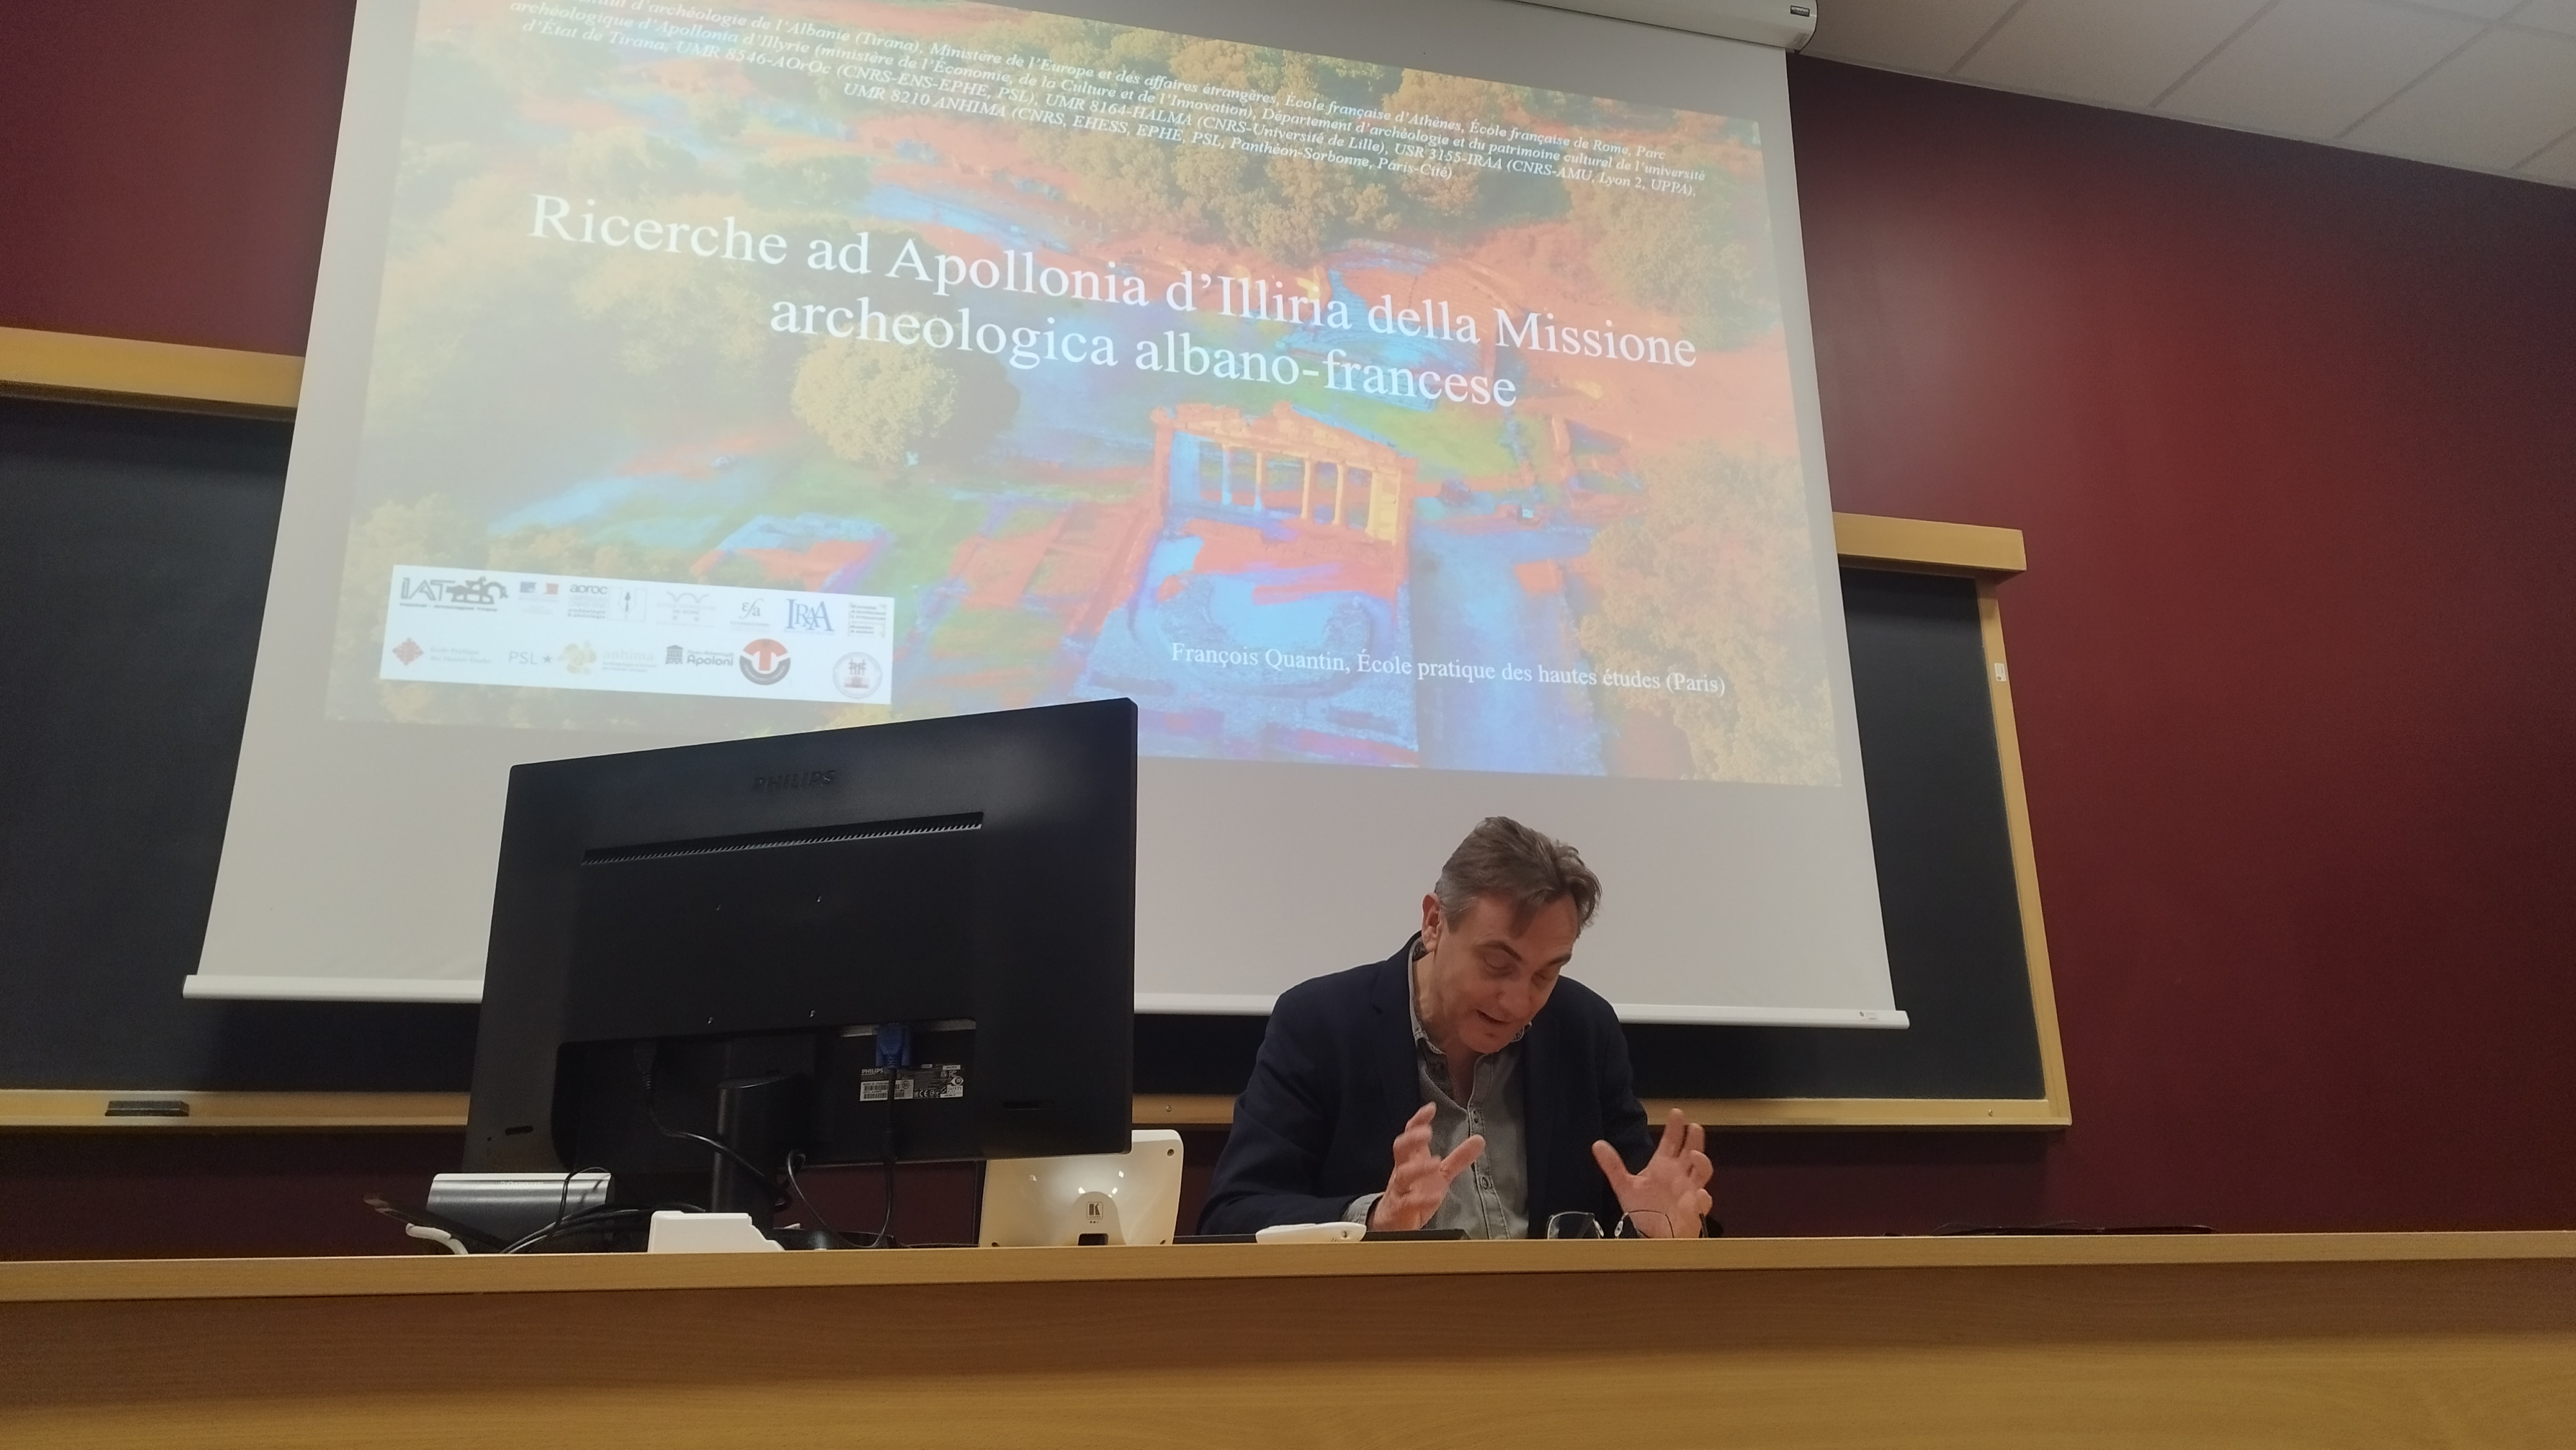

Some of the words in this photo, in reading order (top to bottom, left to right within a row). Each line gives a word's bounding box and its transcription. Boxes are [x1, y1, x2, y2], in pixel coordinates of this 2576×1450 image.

[583, 26, 602, 41] de
[676, 40, 720, 57] UMR
[837, 62, 991, 100] (CNRS-ENS-EPHE,
[1045, 92, 1085, 109] UMR
[1090, 99, 1191, 125] 8164-HALMA
[1197, 113, 1323, 144] (CNRS-Université
[1328, 132, 1345, 146] de
[1348, 135, 1388, 156] Lille),
[1395, 141, 1424, 158] USR
[1600, 170, 1631, 189] Lyon
[1635, 175, 1646, 193] 2,
[1651, 177, 1696, 199] UPPA),
[638, 15, 739, 42] d'Apollonia
[743, 31, 810, 54] d'Illyrie
[815, 41, 894, 65] (ministère
[898, 53, 916, 68] de
[1018, 70, 1036, 85] de
[1041, 73, 1056, 88] la
[1061, 77, 1116, 97] Culture
[1121, 86, 1134, 99] et
[1138, 88, 1156, 102] de
[1262, 105, 1352, 130] Département
[1454, 133, 1465, 146] et
[1468, 135, 1486, 149] du
[1488, 140, 1560, 160] patrimoine
[1564, 149, 1613, 167] culturel
[1616, 155, 1631, 169] de
[1636, 158, 1705, 180] l'université
[752, 14, 772, 29] de
[777, 18, 850, 41] l'Albanie
[929, 41, 1002, 63] Ministère
[1005, 52, 1025, 66] de
[1029, 55, 1095, 80] l'Europe
[1098, 66, 1112, 79] et
[1117, 68, 1140, 84] des
[1144, 73, 1198, 92] affaires
[1285, 89, 1324, 110] École
[1327, 98, 1392, 120] française
[1469, 115, 1507, 136] École
[1508, 124, 1571, 145] française
[1574, 133, 1589, 147] de
[1637, 142, 1666, 158] Parc
[844, 81, 885, 99] UMR
[890, 88, 930, 105] 8210
[933, 93, 1005, 115] ANHIMA
[1011, 104, 1067, 128] (CNRS,
[1073, 113, 1131, 137] EHESS,
[1136, 122, 1185, 144] EPHE,
[1191, 129, 1224, 150] PSL,
[1378, 155, 1452, 182] Paris-Cité)
[529, 195, 788, 265] Ricerche
[807, 232, 870, 276] ad
[885, 238, 1150, 307] Apollonia
[1166, 272, 1352, 330] d'Illiria
[1368, 294, 1481, 346] della
[1493, 308, 1697, 367] Missione
[771, 297, 1118, 369] archeologica
[1135, 331, 1517, 407] albano-francese
[570, 585, 608, 594] aoroc
[785, 599, 835, 631] IRAA
[509, 651, 538, 664] PSL
[687, 654, 734, 667] Apoloni
[1171, 643, 1259, 667] François
[1265, 647, 1350, 674] Quantin,
[1358, 648, 1411, 673] École
[1417, 657, 1495, 682] pratique
[1501, 662, 1533, 681] des
[1539, 664, 1596, 684] hautes
[1602, 668, 1660, 689] études
[1665, 672, 1725, 696] (Paris)
